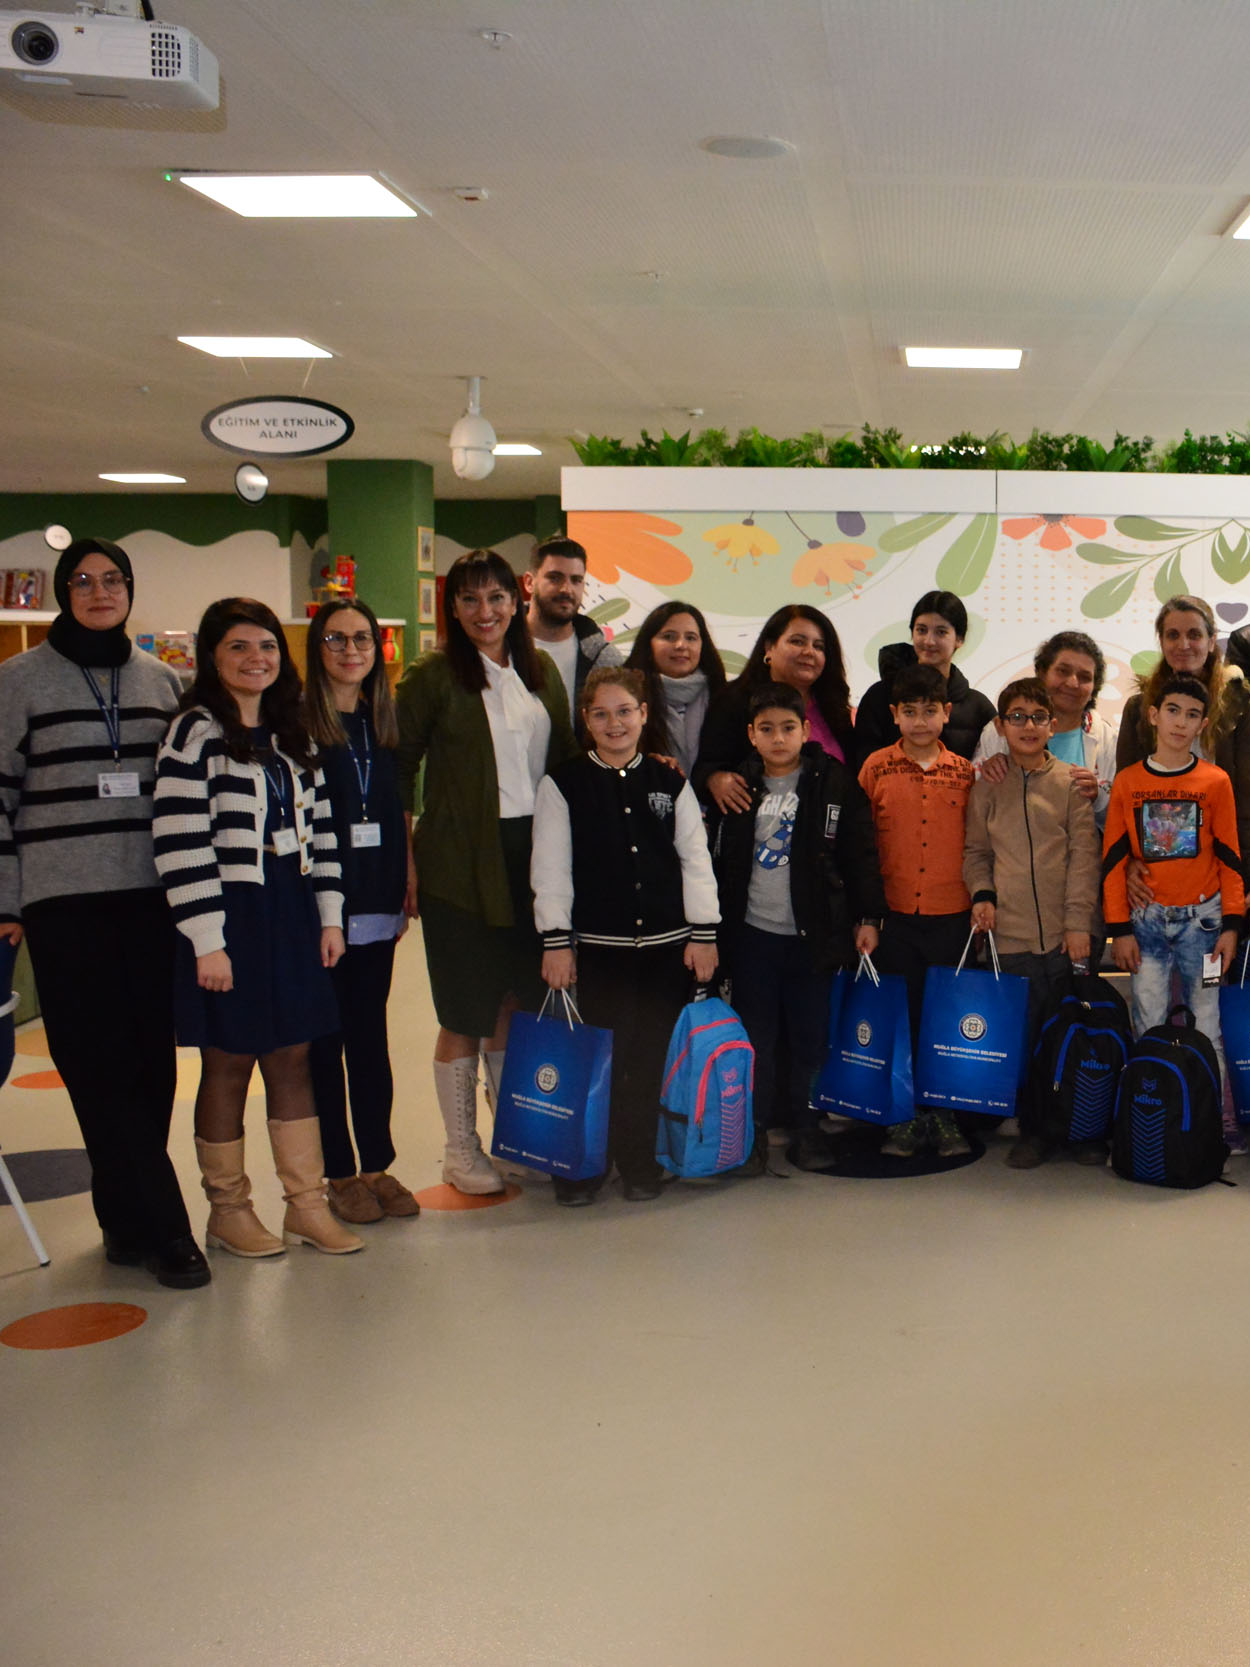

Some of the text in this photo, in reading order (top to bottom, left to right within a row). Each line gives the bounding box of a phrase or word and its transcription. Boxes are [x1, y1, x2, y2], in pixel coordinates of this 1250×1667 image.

[217, 415, 337, 427] EĞİTİM VE ETKİNLİK
[260, 430, 298, 439] ALANI
